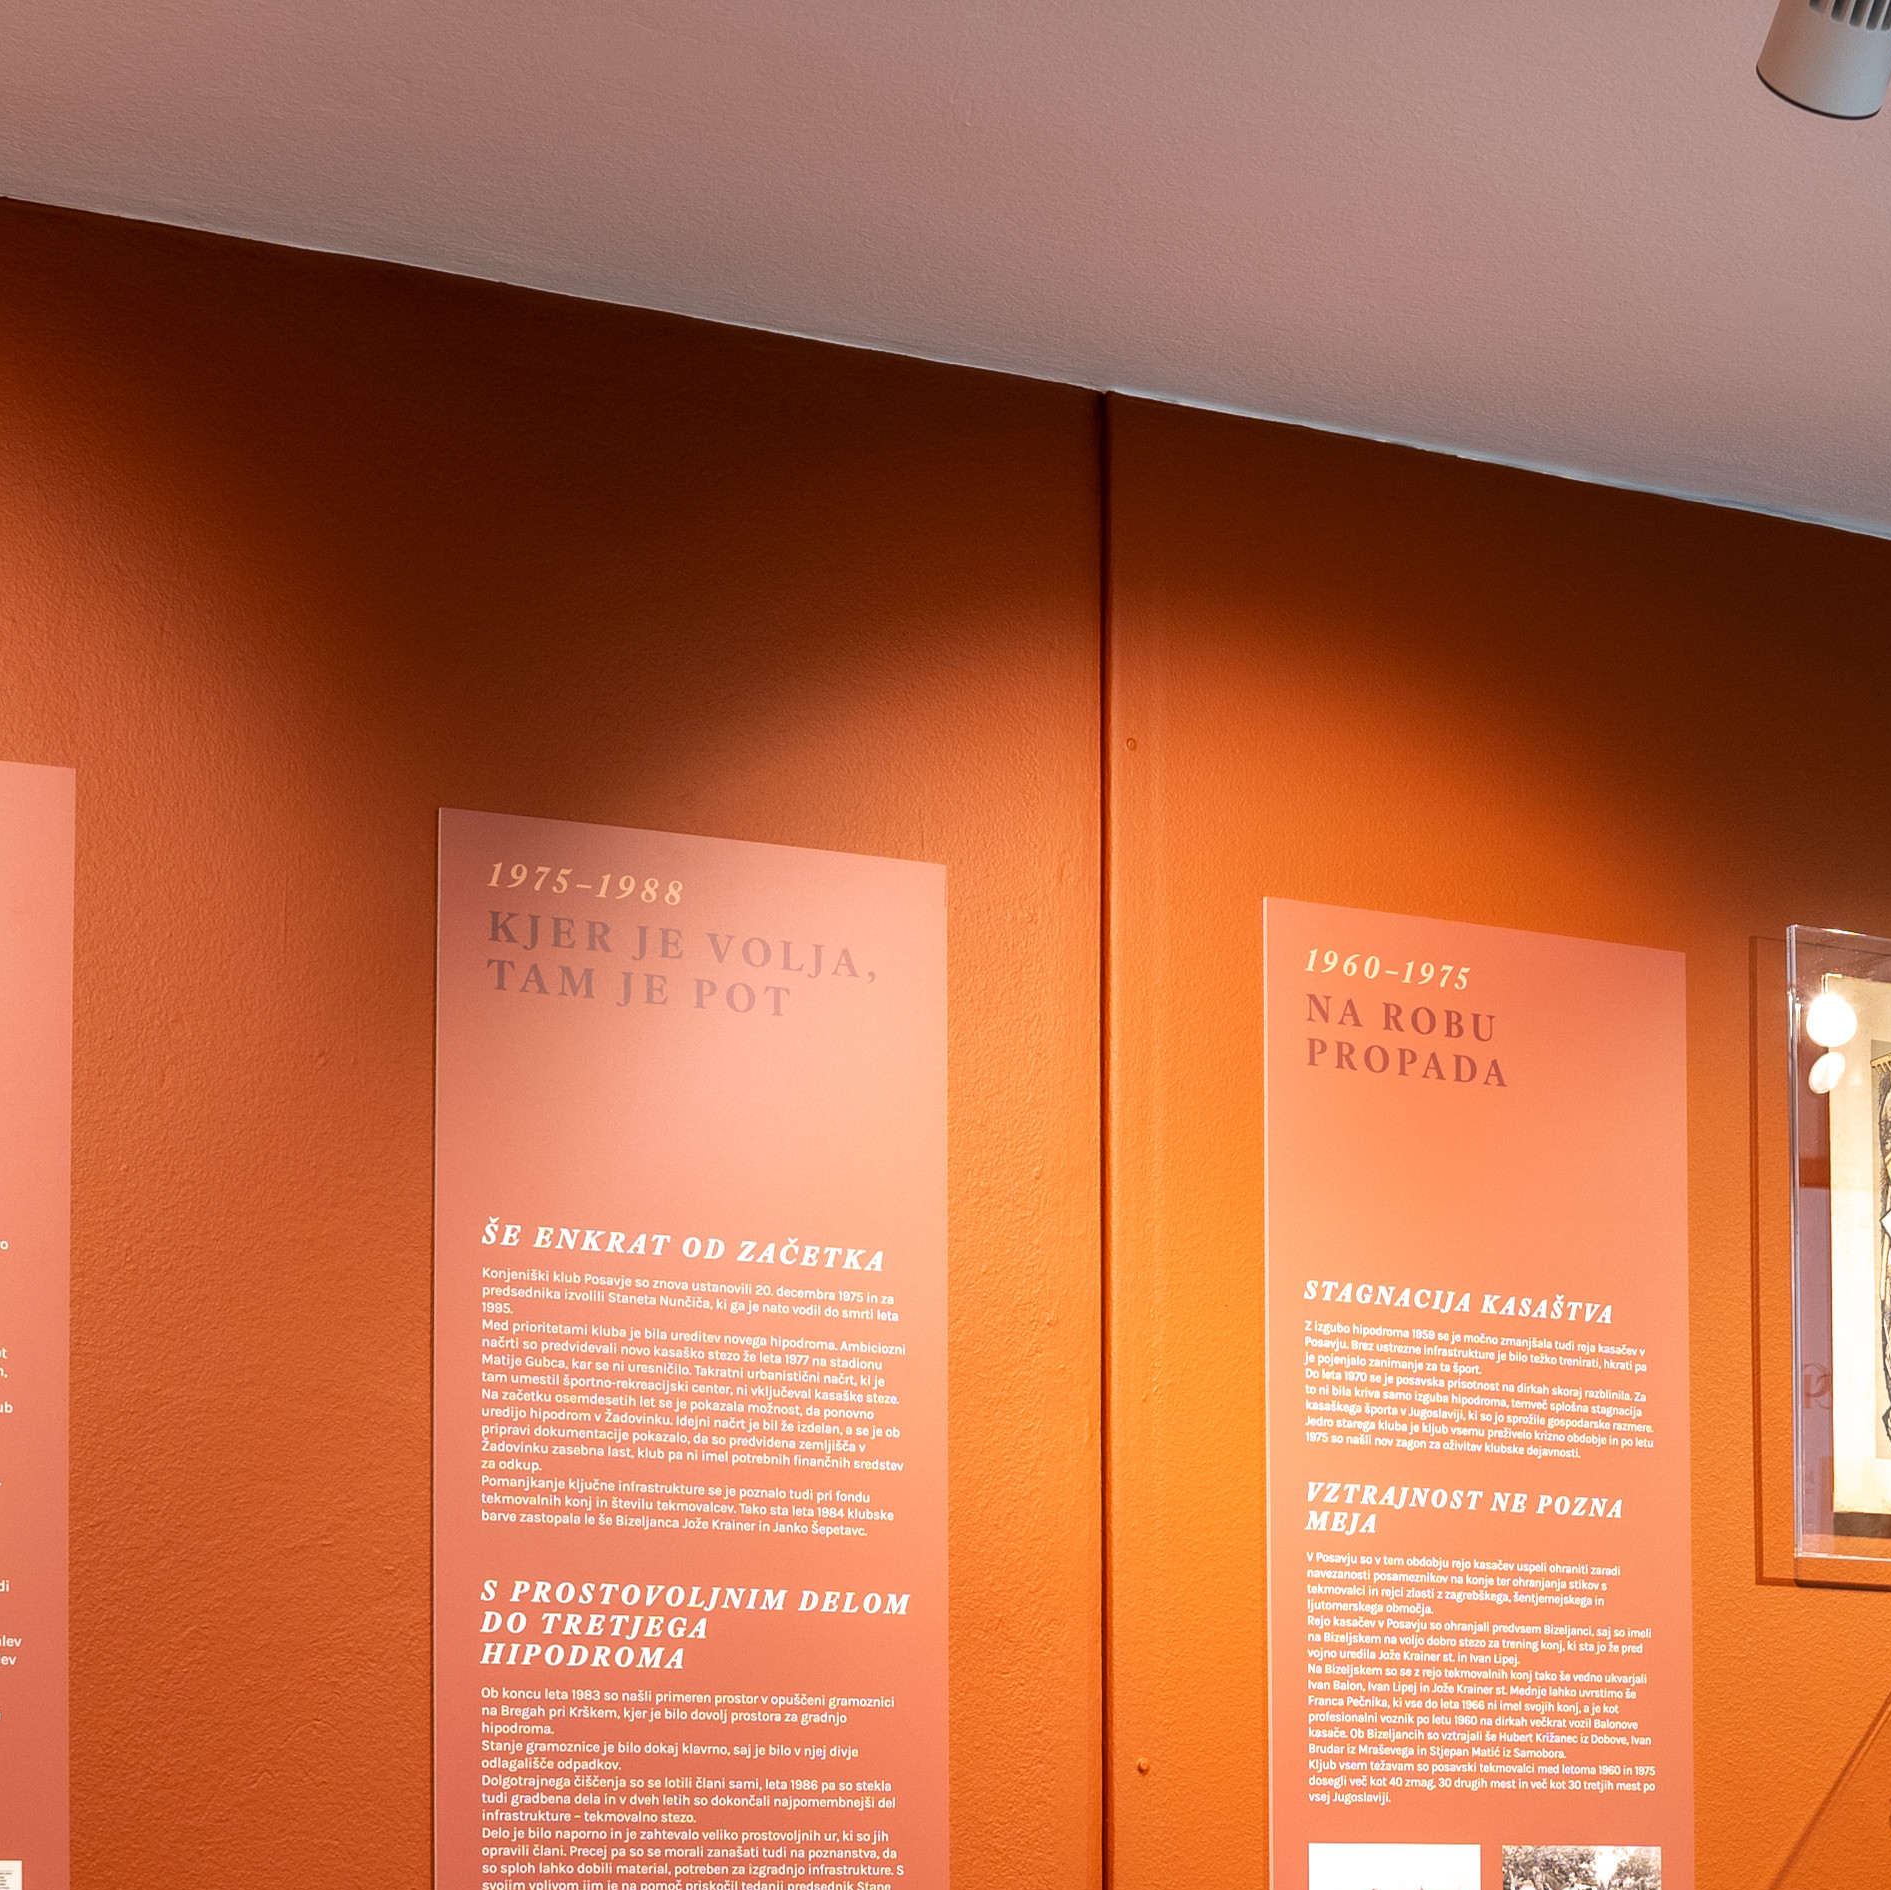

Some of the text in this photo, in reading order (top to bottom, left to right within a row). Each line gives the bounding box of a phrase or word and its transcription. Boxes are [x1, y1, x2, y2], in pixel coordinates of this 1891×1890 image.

[487, 862, 682, 905] 1975–1988
[489, 910, 875, 982] KJER JE VOLJA,
[1305, 949, 1470, 989] 1960–1975
[487, 959, 789, 1016] TAM JE POT
[1307, 994, 1494, 1041] NA ROBU
[1308, 1038, 1506, 1087] PROPADA
[482, 1216, 882, 1271] ŠE ENKRAT OD ZAČETKA
[482, 1302, 512, 1313] 1995.
[1304, 1280, 1611, 1323] STAGNACIJA KASAŠTVA
[1308, 1482, 1621, 1518] VZTRAJNOST NE POZNA
[1304, 1510, 1375, 1535] MEJA
[481, 1580, 910, 1614] S PROSTOVOLJNIM DELOM
[480, 1611, 706, 1639] DO TRETJEGA
[480, 1643, 683, 1668] HIPODROMA
[482, 1722, 553, 1736] hipodroma.
[481, 1757, 621, 1772] odlagališče odpadkov.
[1309, 1791, 1390, 1805] vsej Jugoslaviji.
